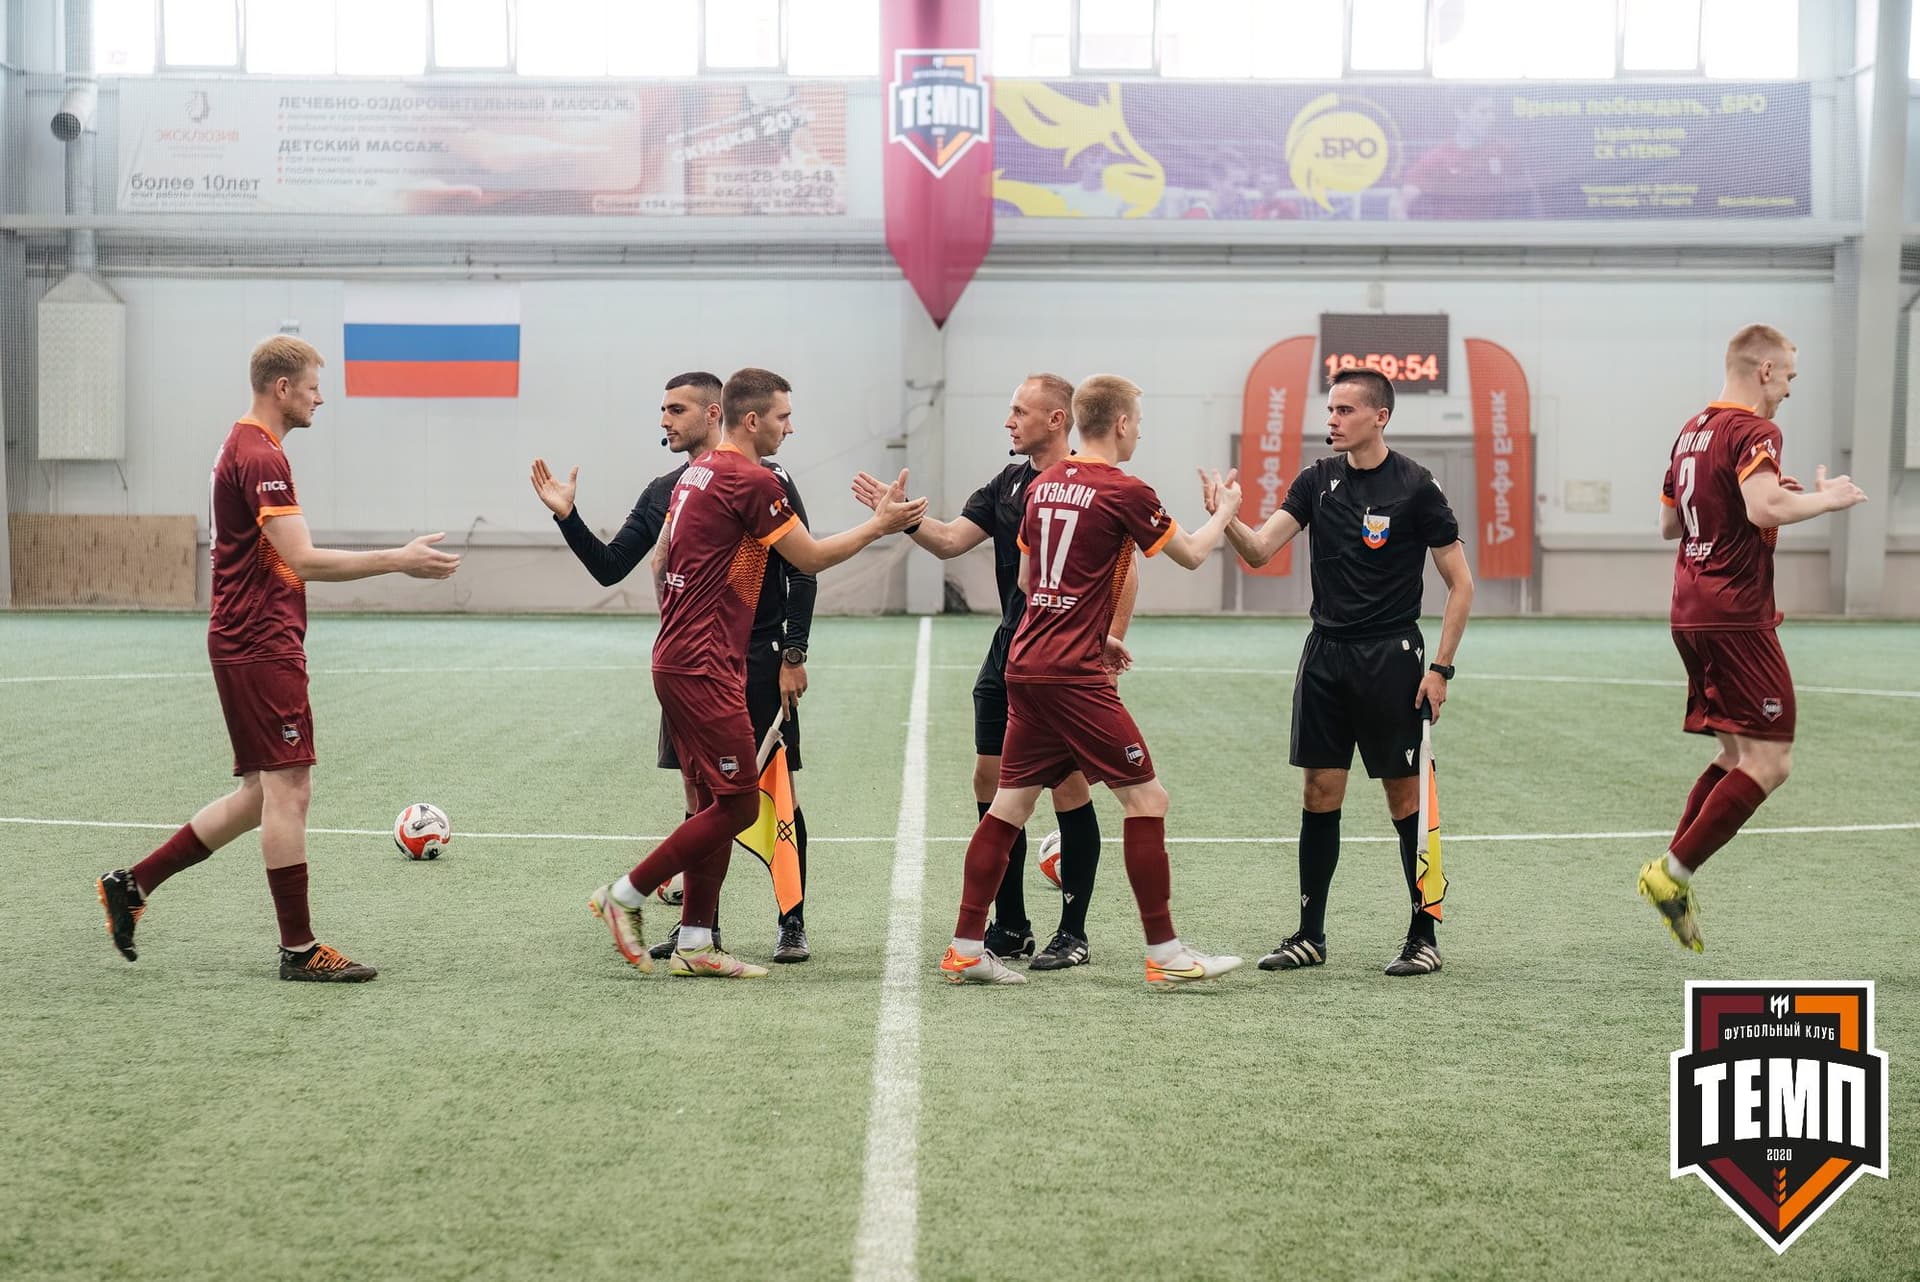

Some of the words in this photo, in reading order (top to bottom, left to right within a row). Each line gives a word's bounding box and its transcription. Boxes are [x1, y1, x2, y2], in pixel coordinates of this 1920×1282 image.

[898, 85, 980, 128] ТЕМП
[278, 137, 360, 153] ДЕТСКИЙ
[1314, 137, 1378, 159] .БРО
[131, 173, 194, 190] более
[203, 174, 261, 191] 10лет
[1261, 386, 1287, 450] Банк
[262, 481, 287, 492] ПСБ
[1033, 481, 1096, 509] КУЗЬКИН
[1679, 457, 1699, 538] 2
[1038, 507, 1079, 590] 17
